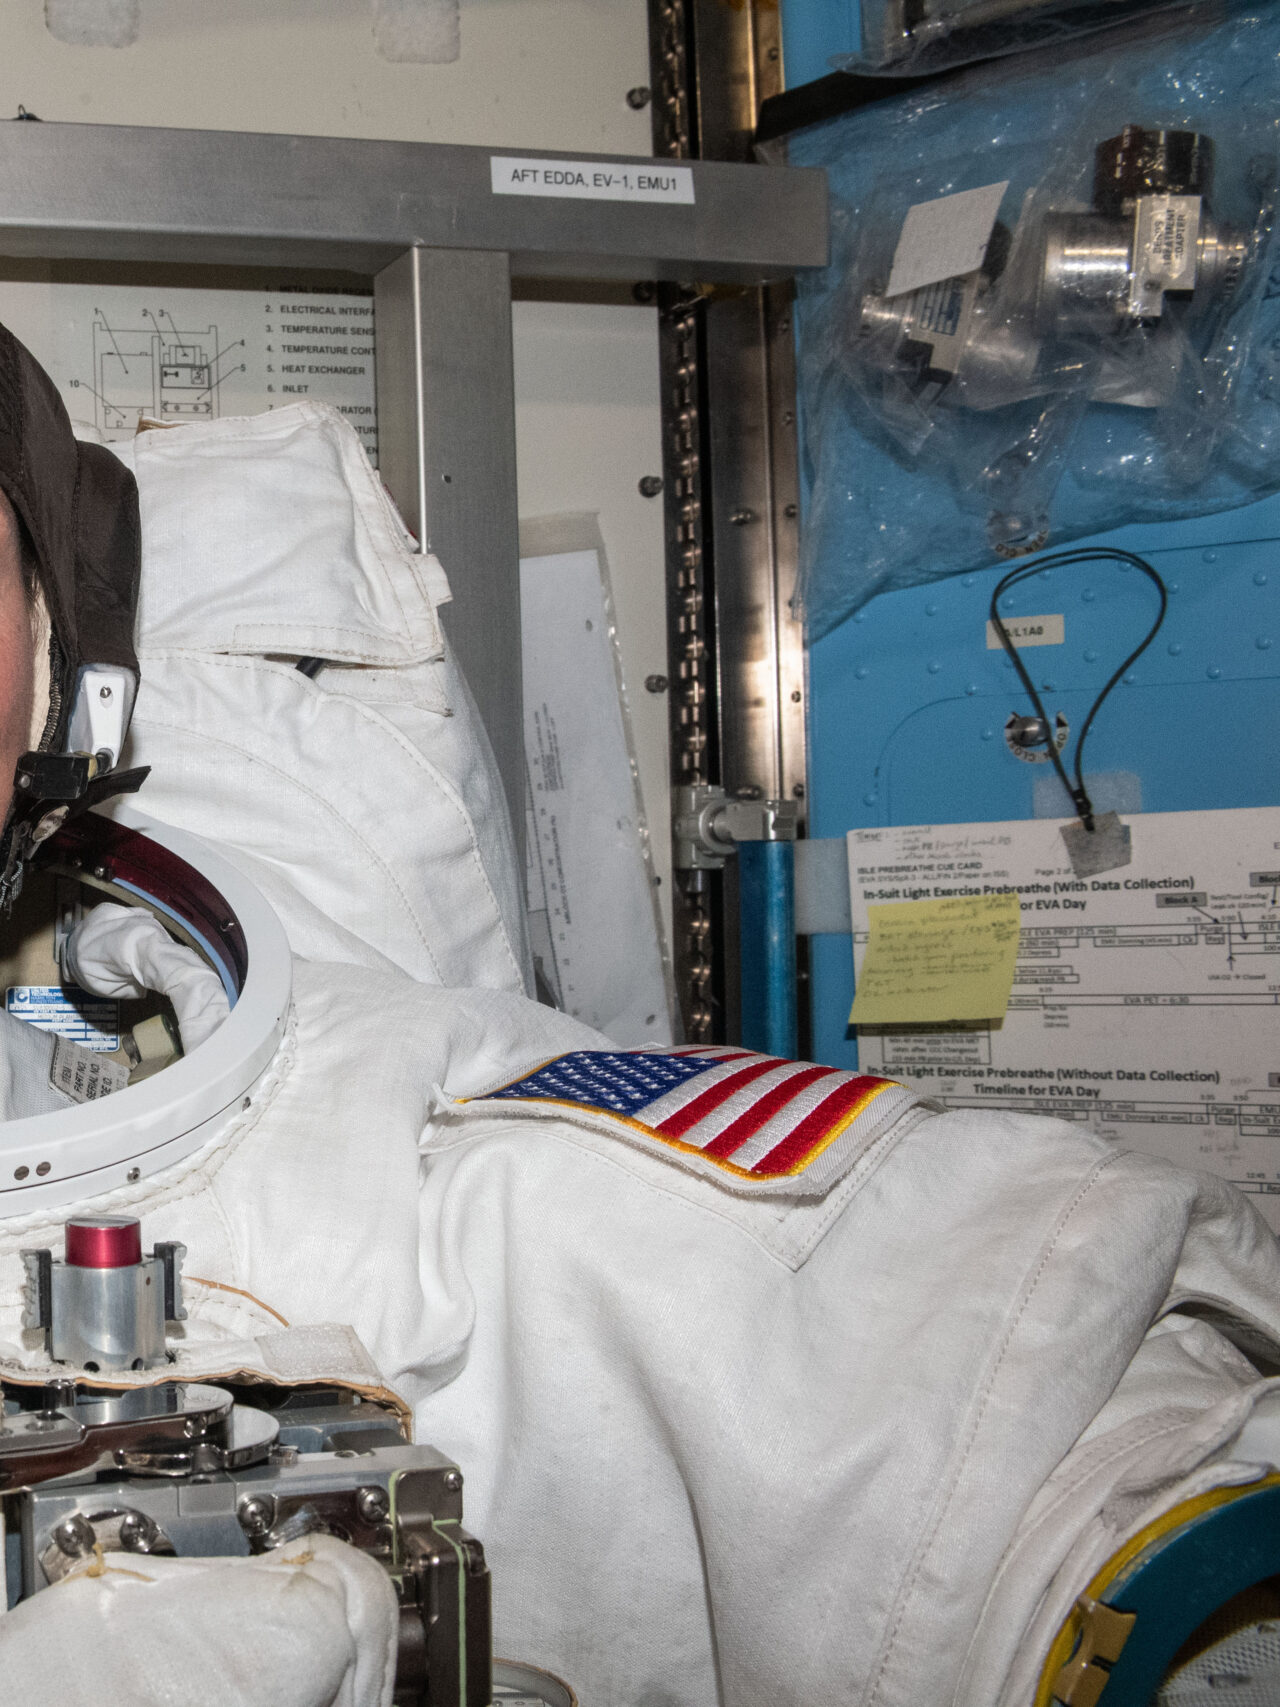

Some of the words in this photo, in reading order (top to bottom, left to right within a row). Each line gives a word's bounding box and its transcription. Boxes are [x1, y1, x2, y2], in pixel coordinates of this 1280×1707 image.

[511, 169, 539, 183] AFT
[543, 170, 589, 188] EDDA,
[593, 174, 634, 190] EV-1,
[637, 176, 677, 191] EMU1
[142, 309, 148, 317] 2
[158, 309, 165, 317] 3
[280, 304, 337, 315] ELECTRICAL
[281, 324, 348, 335] TEMPERATURE
[239, 339, 246, 347] 4
[281, 344, 349, 355] TEMPERATURE
[240, 364, 247, 372] 5
[282, 365, 306, 374] HEAT
[308, 365, 365, 375] EXCHANGER
[69, 379, 80, 388] 10
[282, 384, 309, 393] INLET
[857, 866, 876, 875] ISLE
[878, 863, 935, 874] PREBREATHE
[937, 862, 955, 872] CUE
[957, 861, 983, 870] CARD
[1035, 868, 1055, 877] Page
[1259, 874, 1280, 883] Bloc
[863, 887, 901, 900] In-Suit
[903, 885, 931, 900] Light
[931, 884, 982, 898] Exercise
[984, 881, 1051, 896] Prebreathe
[1052, 880, 1088, 895] (With
[1091, 879, 1121, 891] Data
[1123, 876, 1195, 892] Collection)
[1020, 901, 1033, 910] or
[1035, 899, 1060, 910] EVA
[1063, 898, 1087, 911] Day
[1020, 928, 1032, 936] SLE
[867, 1066, 905, 1077] In-Suit
[906, 1066, 934, 1079] Light
[937, 1067, 985, 1078] Exercise
[987, 1067, 1054, 1080] Prebreathe
[1057, 1068, 1113, 1082] (Without
[1116, 1070, 1145, 1081] Data
[1149, 1069, 1220, 1084] Collection)
[74, 1071, 85, 1092] PART
[86, 1076, 99, 1100] SERIAL
[100, 1084, 112, 1098] DE
[974, 1083, 1026, 1095] Timeline
[1028, 1085, 1046, 1096] for
[1049, 1086, 1073, 1096] EVA
[1076, 1086, 1101, 1099] Day
